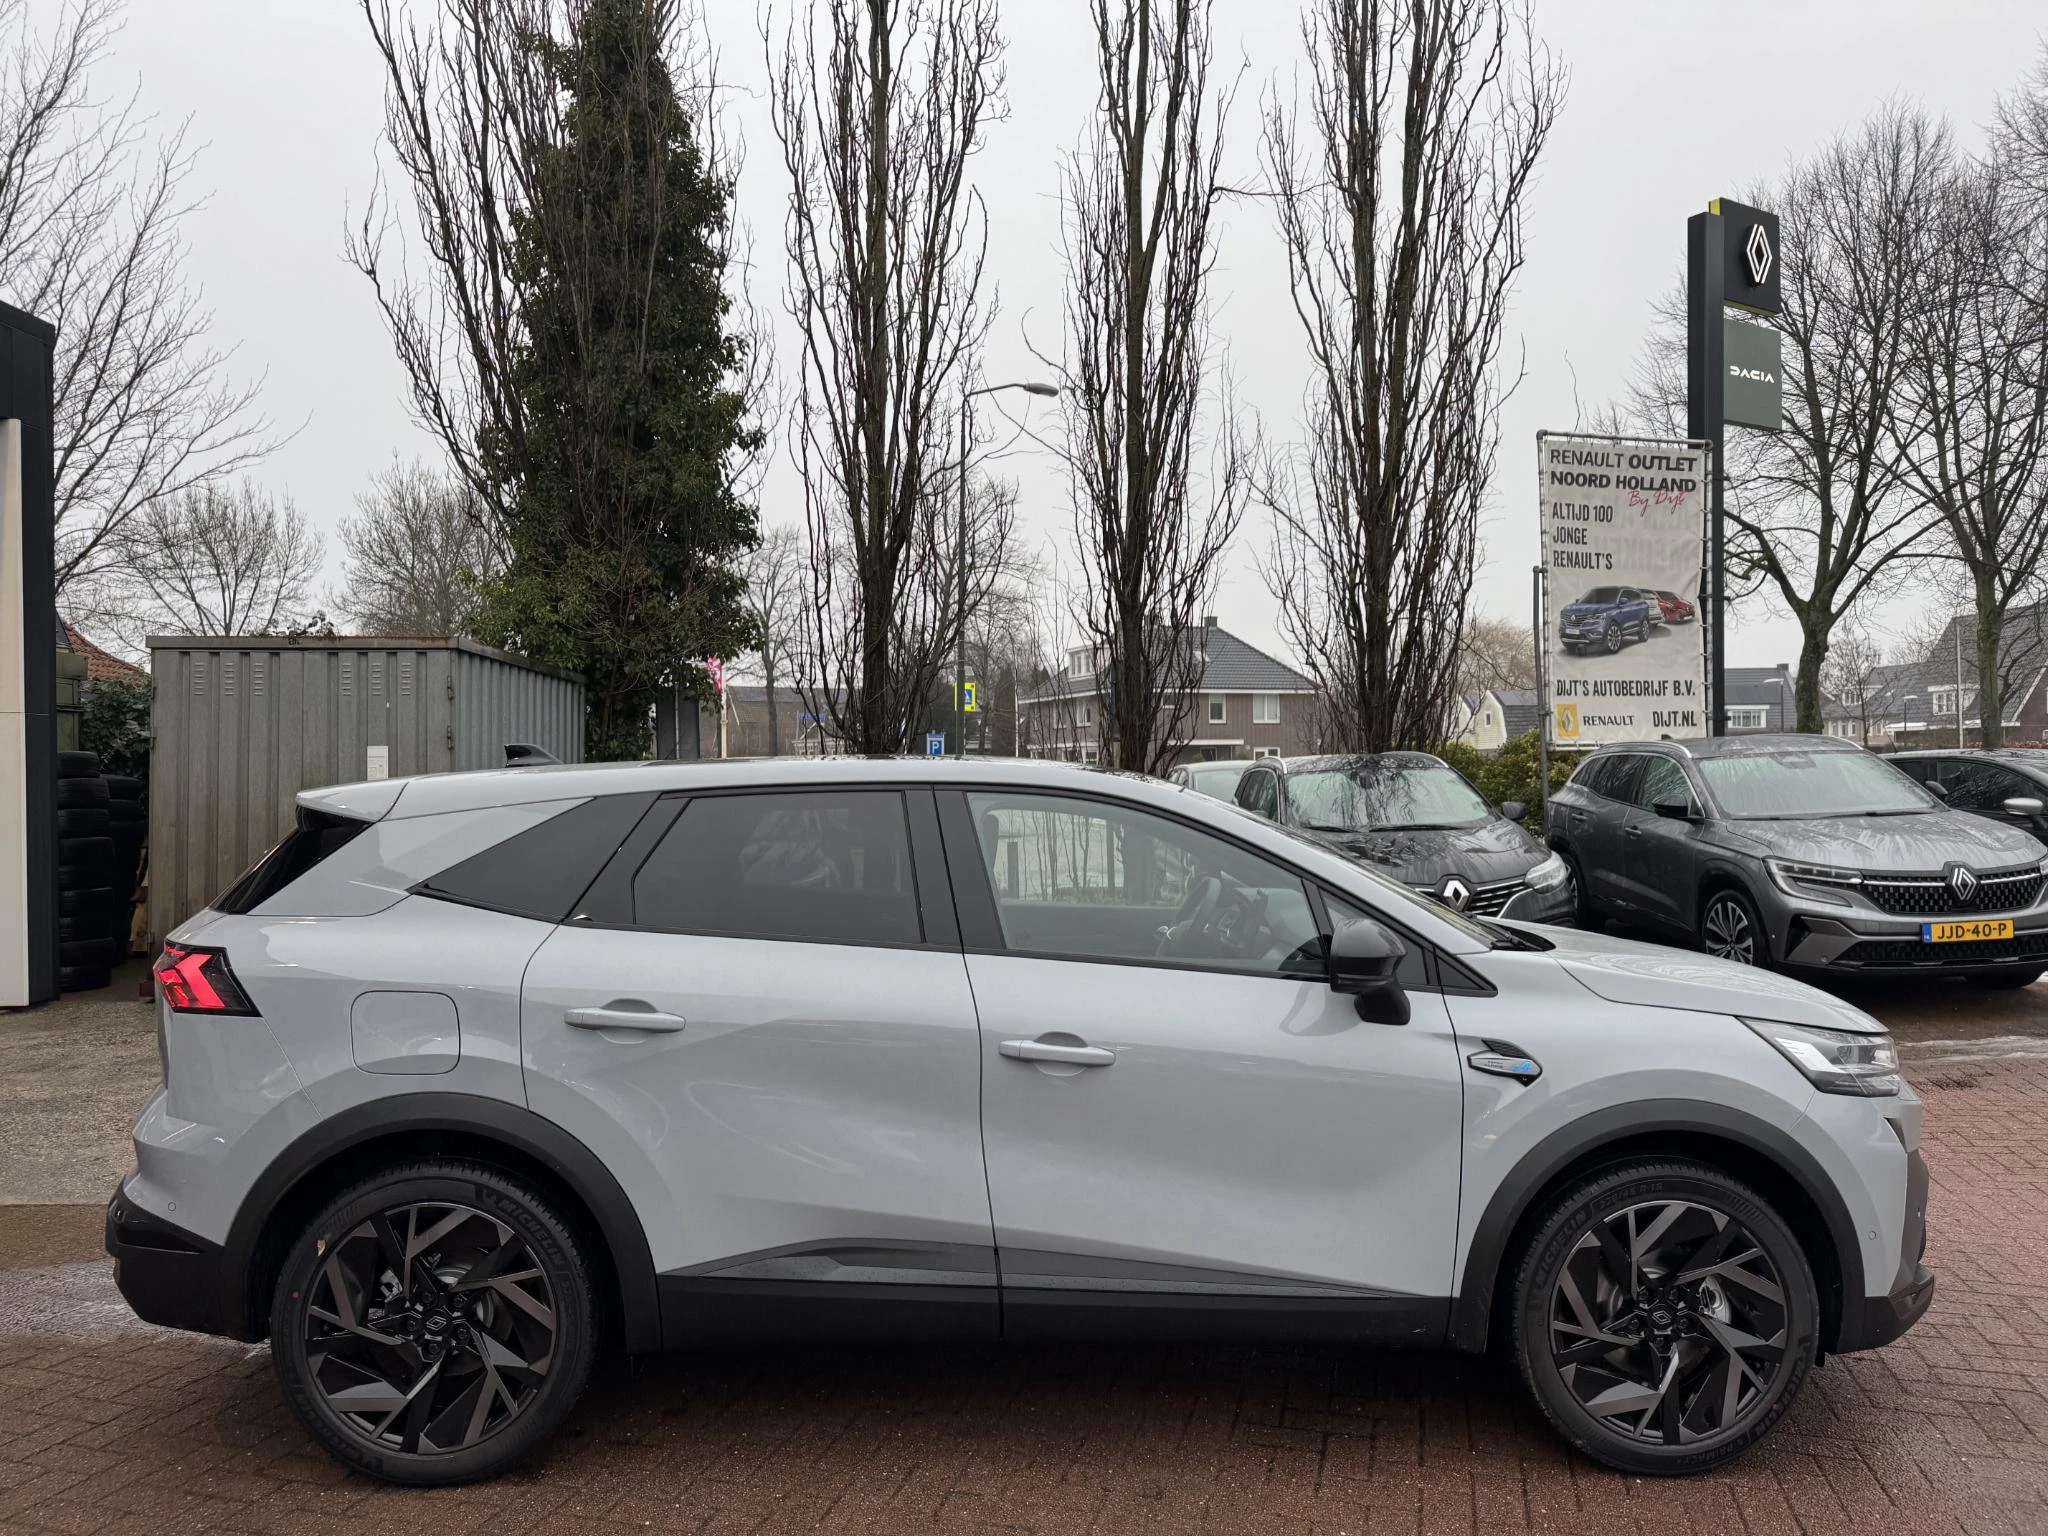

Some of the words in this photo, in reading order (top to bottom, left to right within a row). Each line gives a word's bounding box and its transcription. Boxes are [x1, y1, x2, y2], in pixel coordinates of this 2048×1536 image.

[1730, 365, 1775, 384] DACIA
[1550, 449, 1624, 468] RENAULT
[1628, 454, 1697, 472] OUTLET
[1550, 471, 1611, 488] NOORD
[1615, 475, 1697, 492] HOLLAND
[1552, 502, 1590, 521] ALTIJD
[1593, 505, 1613, 523] 100
[1628, 490, 1649, 517] By
[1553, 526, 1588, 545] JONGE
[1553, 550, 1613, 570] RENAULT'S
[1556, 679, 1589, 696] DIJT'S
[1593, 680, 1668, 696] AUTOBEDRIJF
[1673, 680, 1696, 696] B.V.
[1583, 715, 1634, 726] RENAULT
[1653, 710, 1697, 727] DIJT.NL
[1937, 922, 2007, 940] JJD-40-P
